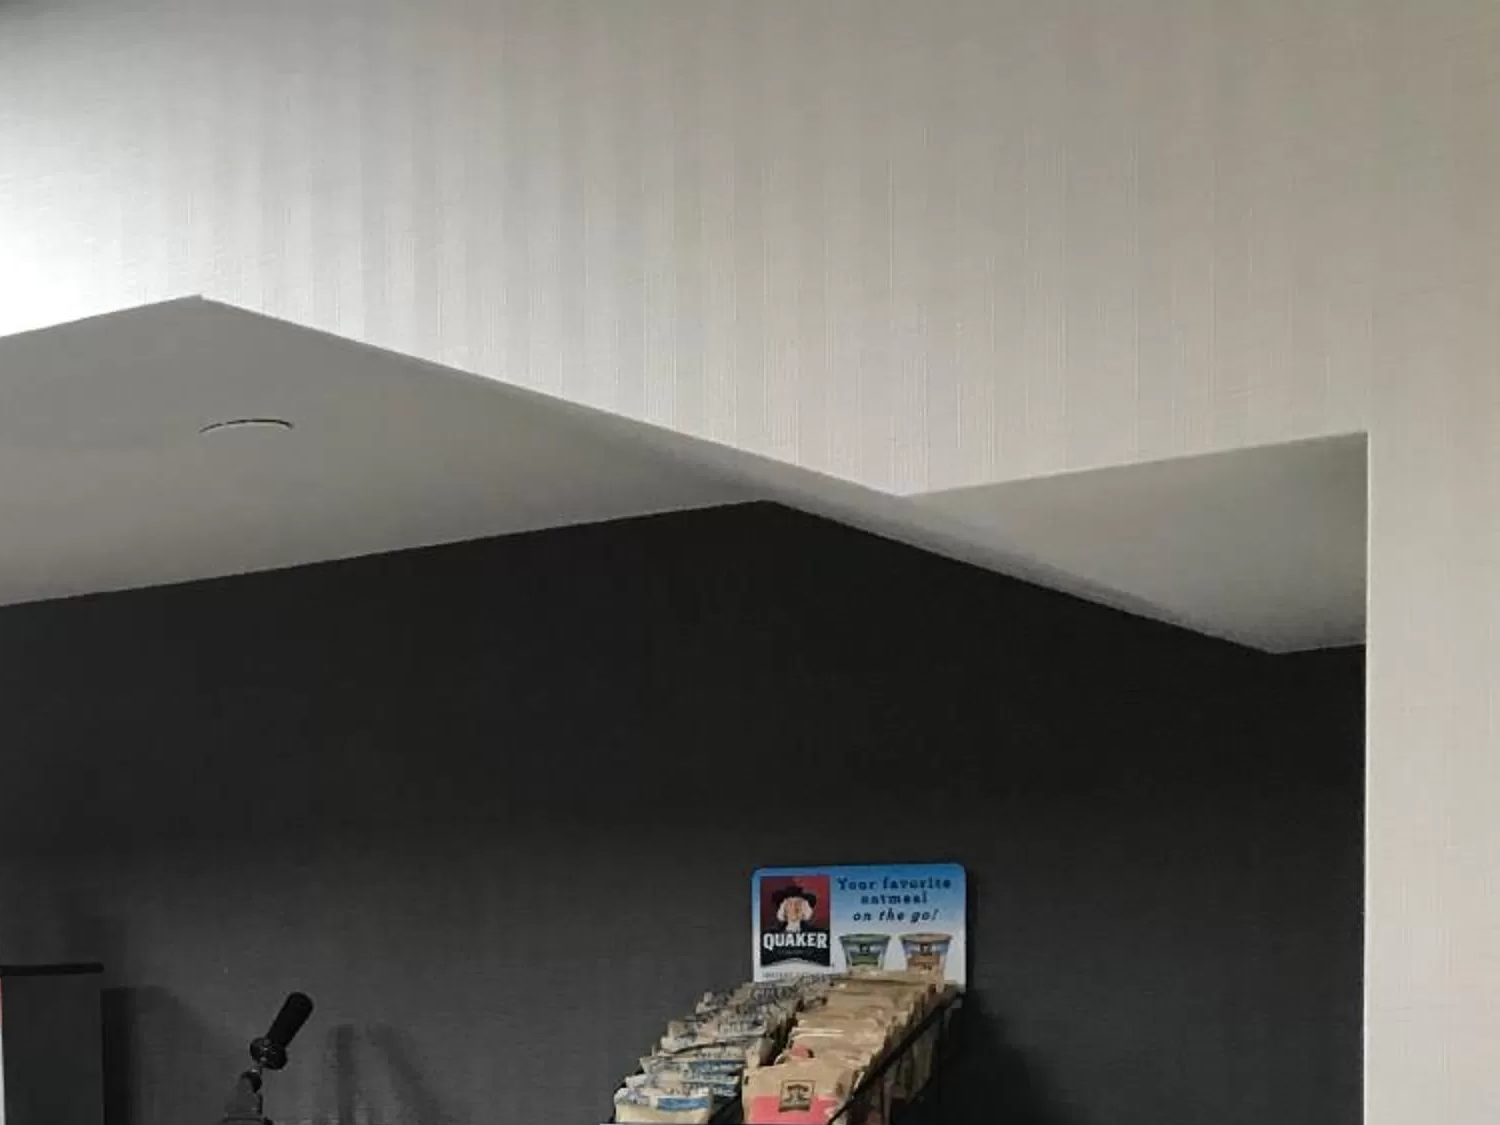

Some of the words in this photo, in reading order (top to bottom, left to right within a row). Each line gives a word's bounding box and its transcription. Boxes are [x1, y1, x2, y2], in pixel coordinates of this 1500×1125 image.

[836, 877, 877, 891] Your
[882, 876, 952, 890] favorite
[860, 890, 928, 905] oatmeal
[853, 910, 873, 922] on
[878, 908, 905, 922] the
[910, 908, 940, 924] go!
[763, 932, 829, 950] QUAKER
